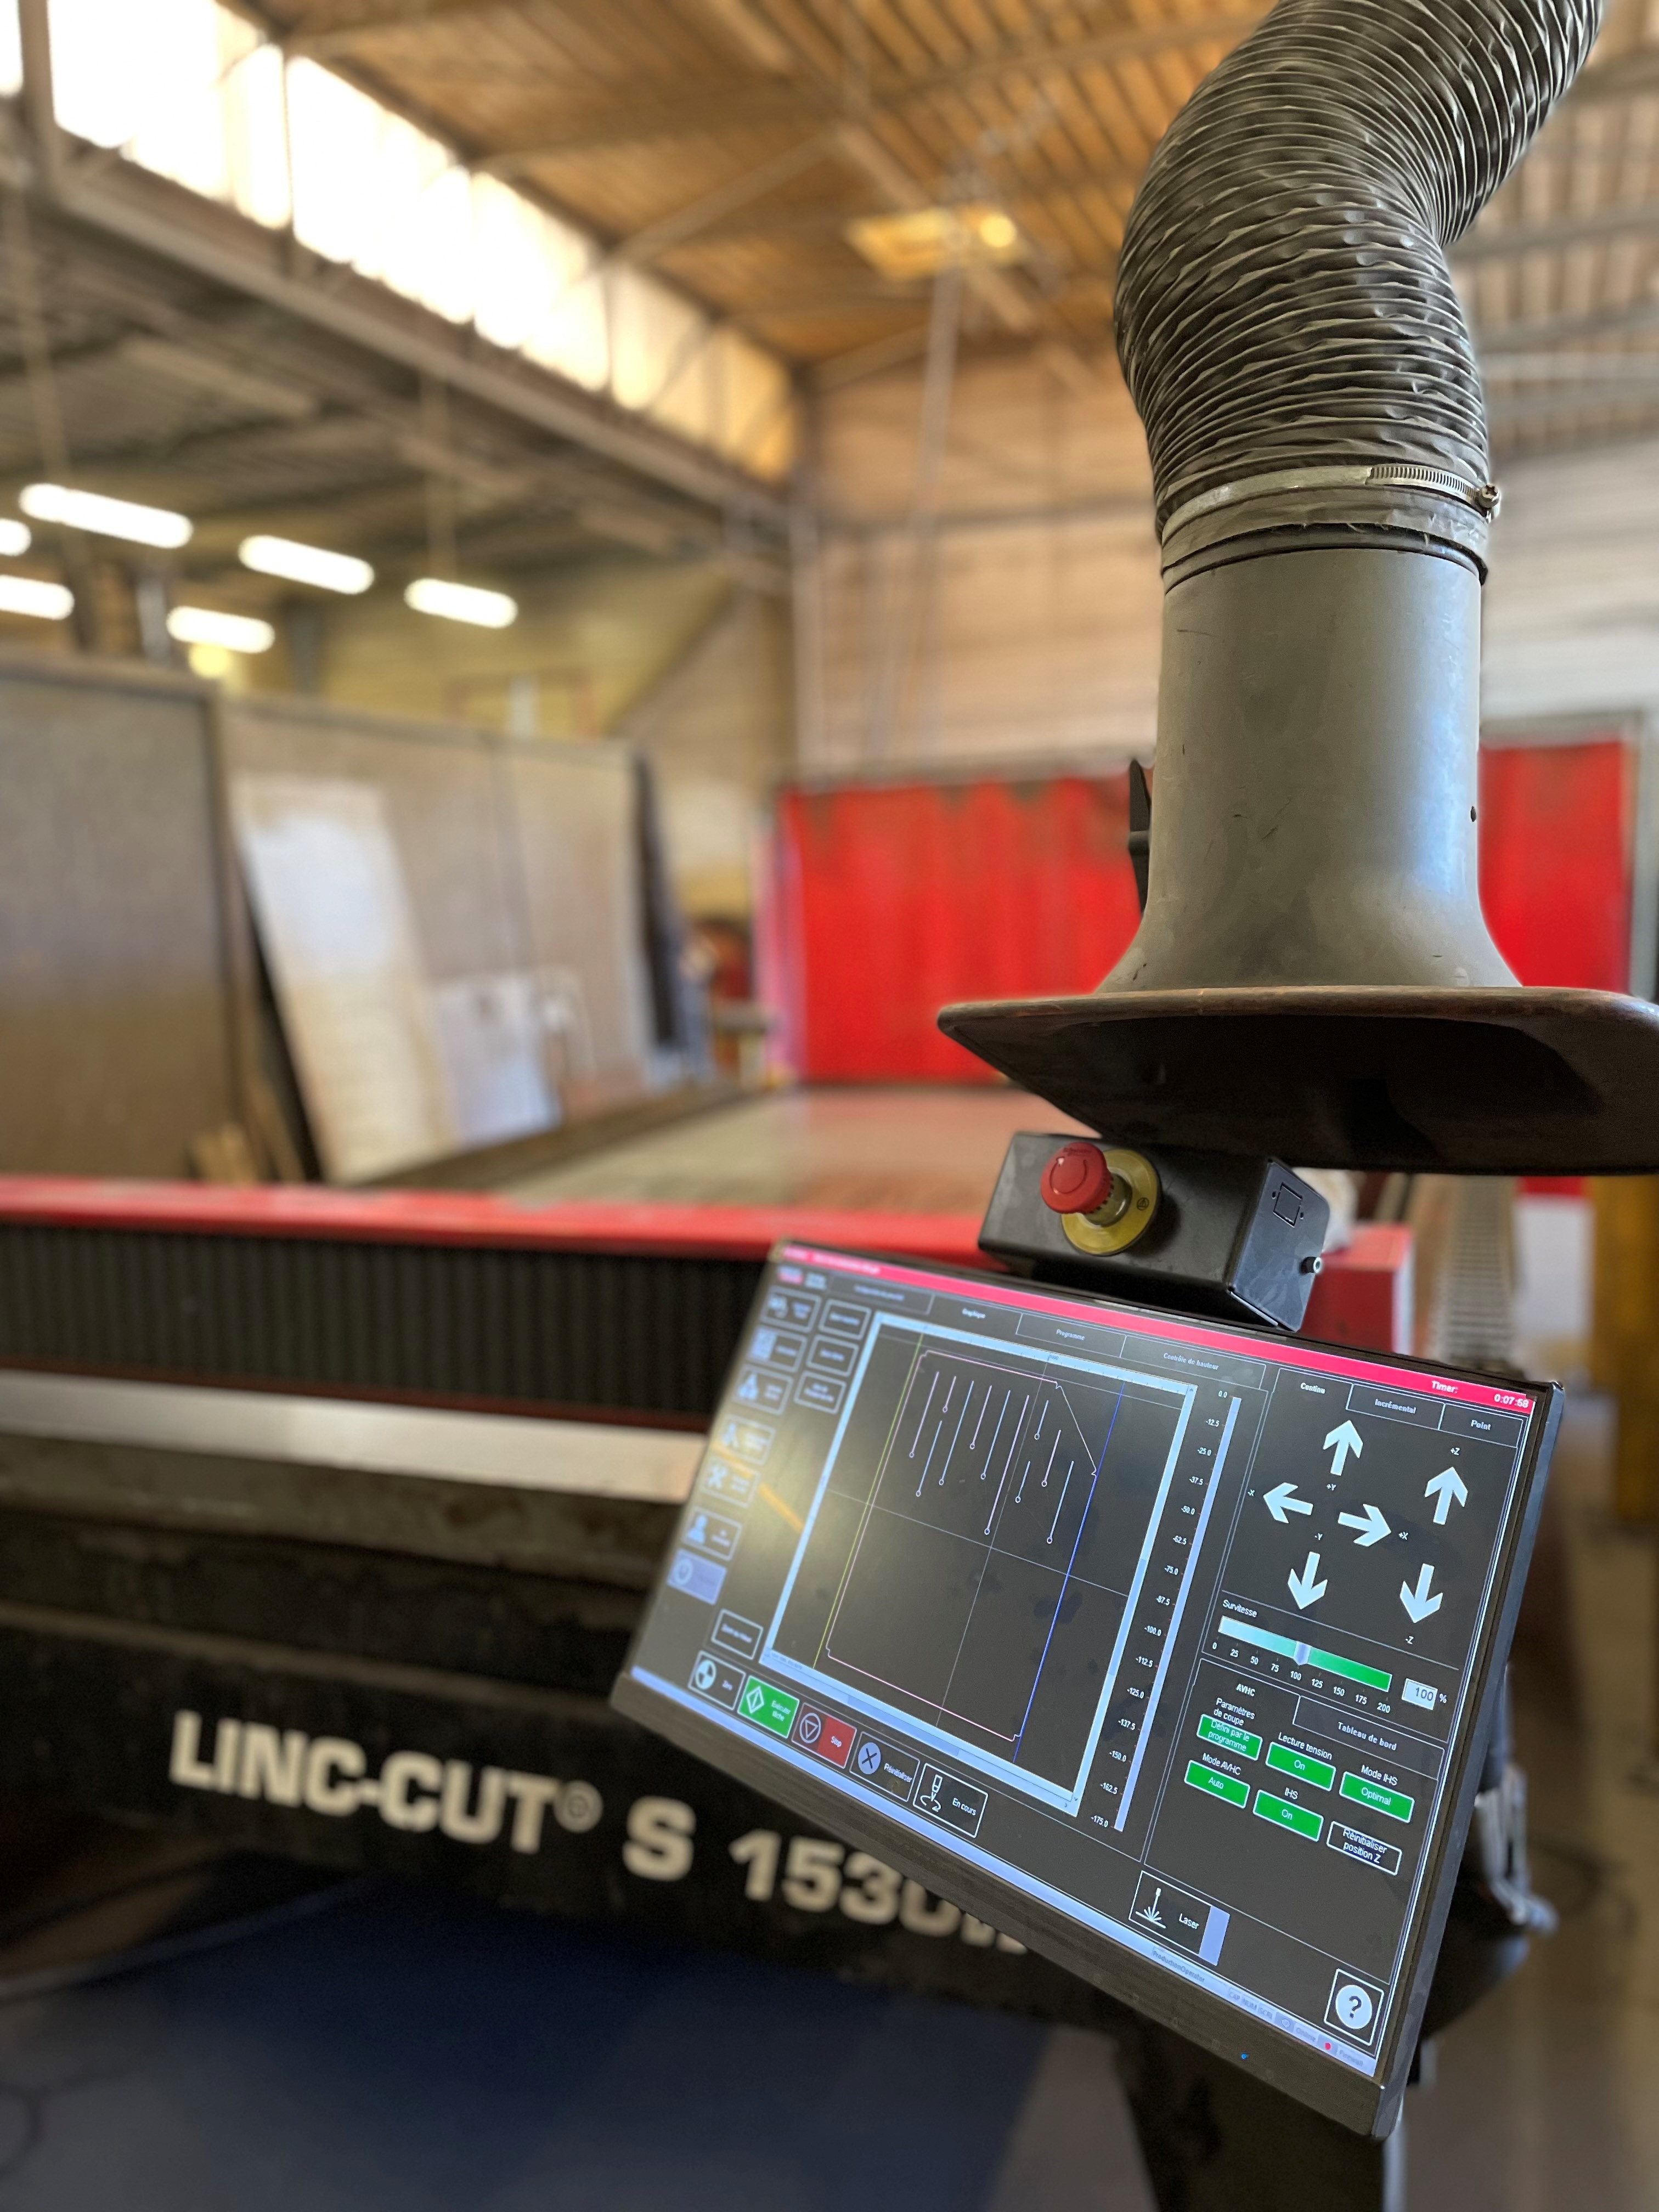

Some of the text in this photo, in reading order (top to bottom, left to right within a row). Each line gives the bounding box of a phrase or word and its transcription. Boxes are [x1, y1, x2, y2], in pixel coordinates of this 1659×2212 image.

[1056, 1329, 1085, 1341] Programme
[1164, 1353, 1187, 1363] Contrôle
[1197, 1360, 1219, 1370] hauteur
[1300, 1382, 1325, 1394] Continu
[1432, 1380, 1458, 1394] Timer:
[1375, 1399, 1416, 1414] Incrémental
[1206, 1419, 1219, 1427] -12.5
[1471, 1419, 1491, 1431] Point
[1197, 1447, 1211, 1455] -25.0
[1450, 1447, 1460, 1455] +Z
[1189, 1476, 1203, 1485] -37.5
[1327, 1483, 1336, 1491] +Y
[1181, 1506, 1195, 1515] -50.0
[1173, 1536, 1187, 1545] -62.5
[1399, 1532, 1408, 1540] +X
[1164, 1565, 1178, 1575] -75.0
[1156, 1595, 1170, 1606] -87.5
[1223, 1599, 1257, 1618] Survitesse
[1144, 1626, 1162, 1636] -100.0
[1406, 1636, 1414, 1644] -Z
[1136, 1656, 1153, 1667] -112.5
[1230, 1649, 1238, 1657] 25
[1250, 1656, 1259, 1665] 50
[1271, 1663, 1279, 1673] 75
[1290, 1671, 1301, 1681] 100
[1312, 1678, 1323, 1689] 125
[1333, 1686, 1345, 1696] 150
[1356, 1694, 1367, 1705] 175
[1377, 1702, 1390, 1713] 200
[1127, 1687, 1144, 1699] -125.0
[1237, 1684, 1255, 1696] AVHC
[1415, 1687, 1447, 1703] 100 %
[1216, 1698, 1255, 1720] Paramètres
[1214, 1708, 1244, 1726] de coupe
[1118, 1719, 1136, 1730] -137.5
[1211, 1720, 1250, 1742] Défini par le
[1338, 1722, 1397, 1751] Tableau de bord
[831, 1736, 842, 1747] Stop
[1208, 1730, 1246, 1751] programme
[1278, 1733, 1332, 1759] Lecture tension
[1109, 1751, 1127, 1762] -150.0
[1203, 1753, 1241, 1775] Mode AVHC
[1294, 1760, 1305, 1770] On
[884, 1763, 913, 1783] Réinitialiser
[1362, 1765, 1398, 1786] Mode IHS
[1100, 1782, 1118, 1795] -162.5
[1209, 1776, 1223, 1789] Auto
[1285, 1788, 1299, 1799] IHS
[1362, 1787, 1391, 1805] Optimal
[952, 1798, 976, 1816] En cours
[1282, 1809, 1293, 1820] On
[1091, 1815, 1108, 1827] -175.0
[621, 1794, 697, 1883] S
[1343, 1829, 1387, 1854] Réinitialiser
[1344, 1841, 1380, 1863] position Z
[1179, 1914, 1199, 1929] Laser
[1153, 1951, 1205, 1982] ProductionOperator
[1243, 1998, 1257, 2010] NUM
[1349, 1995, 1362, 2019] ?
